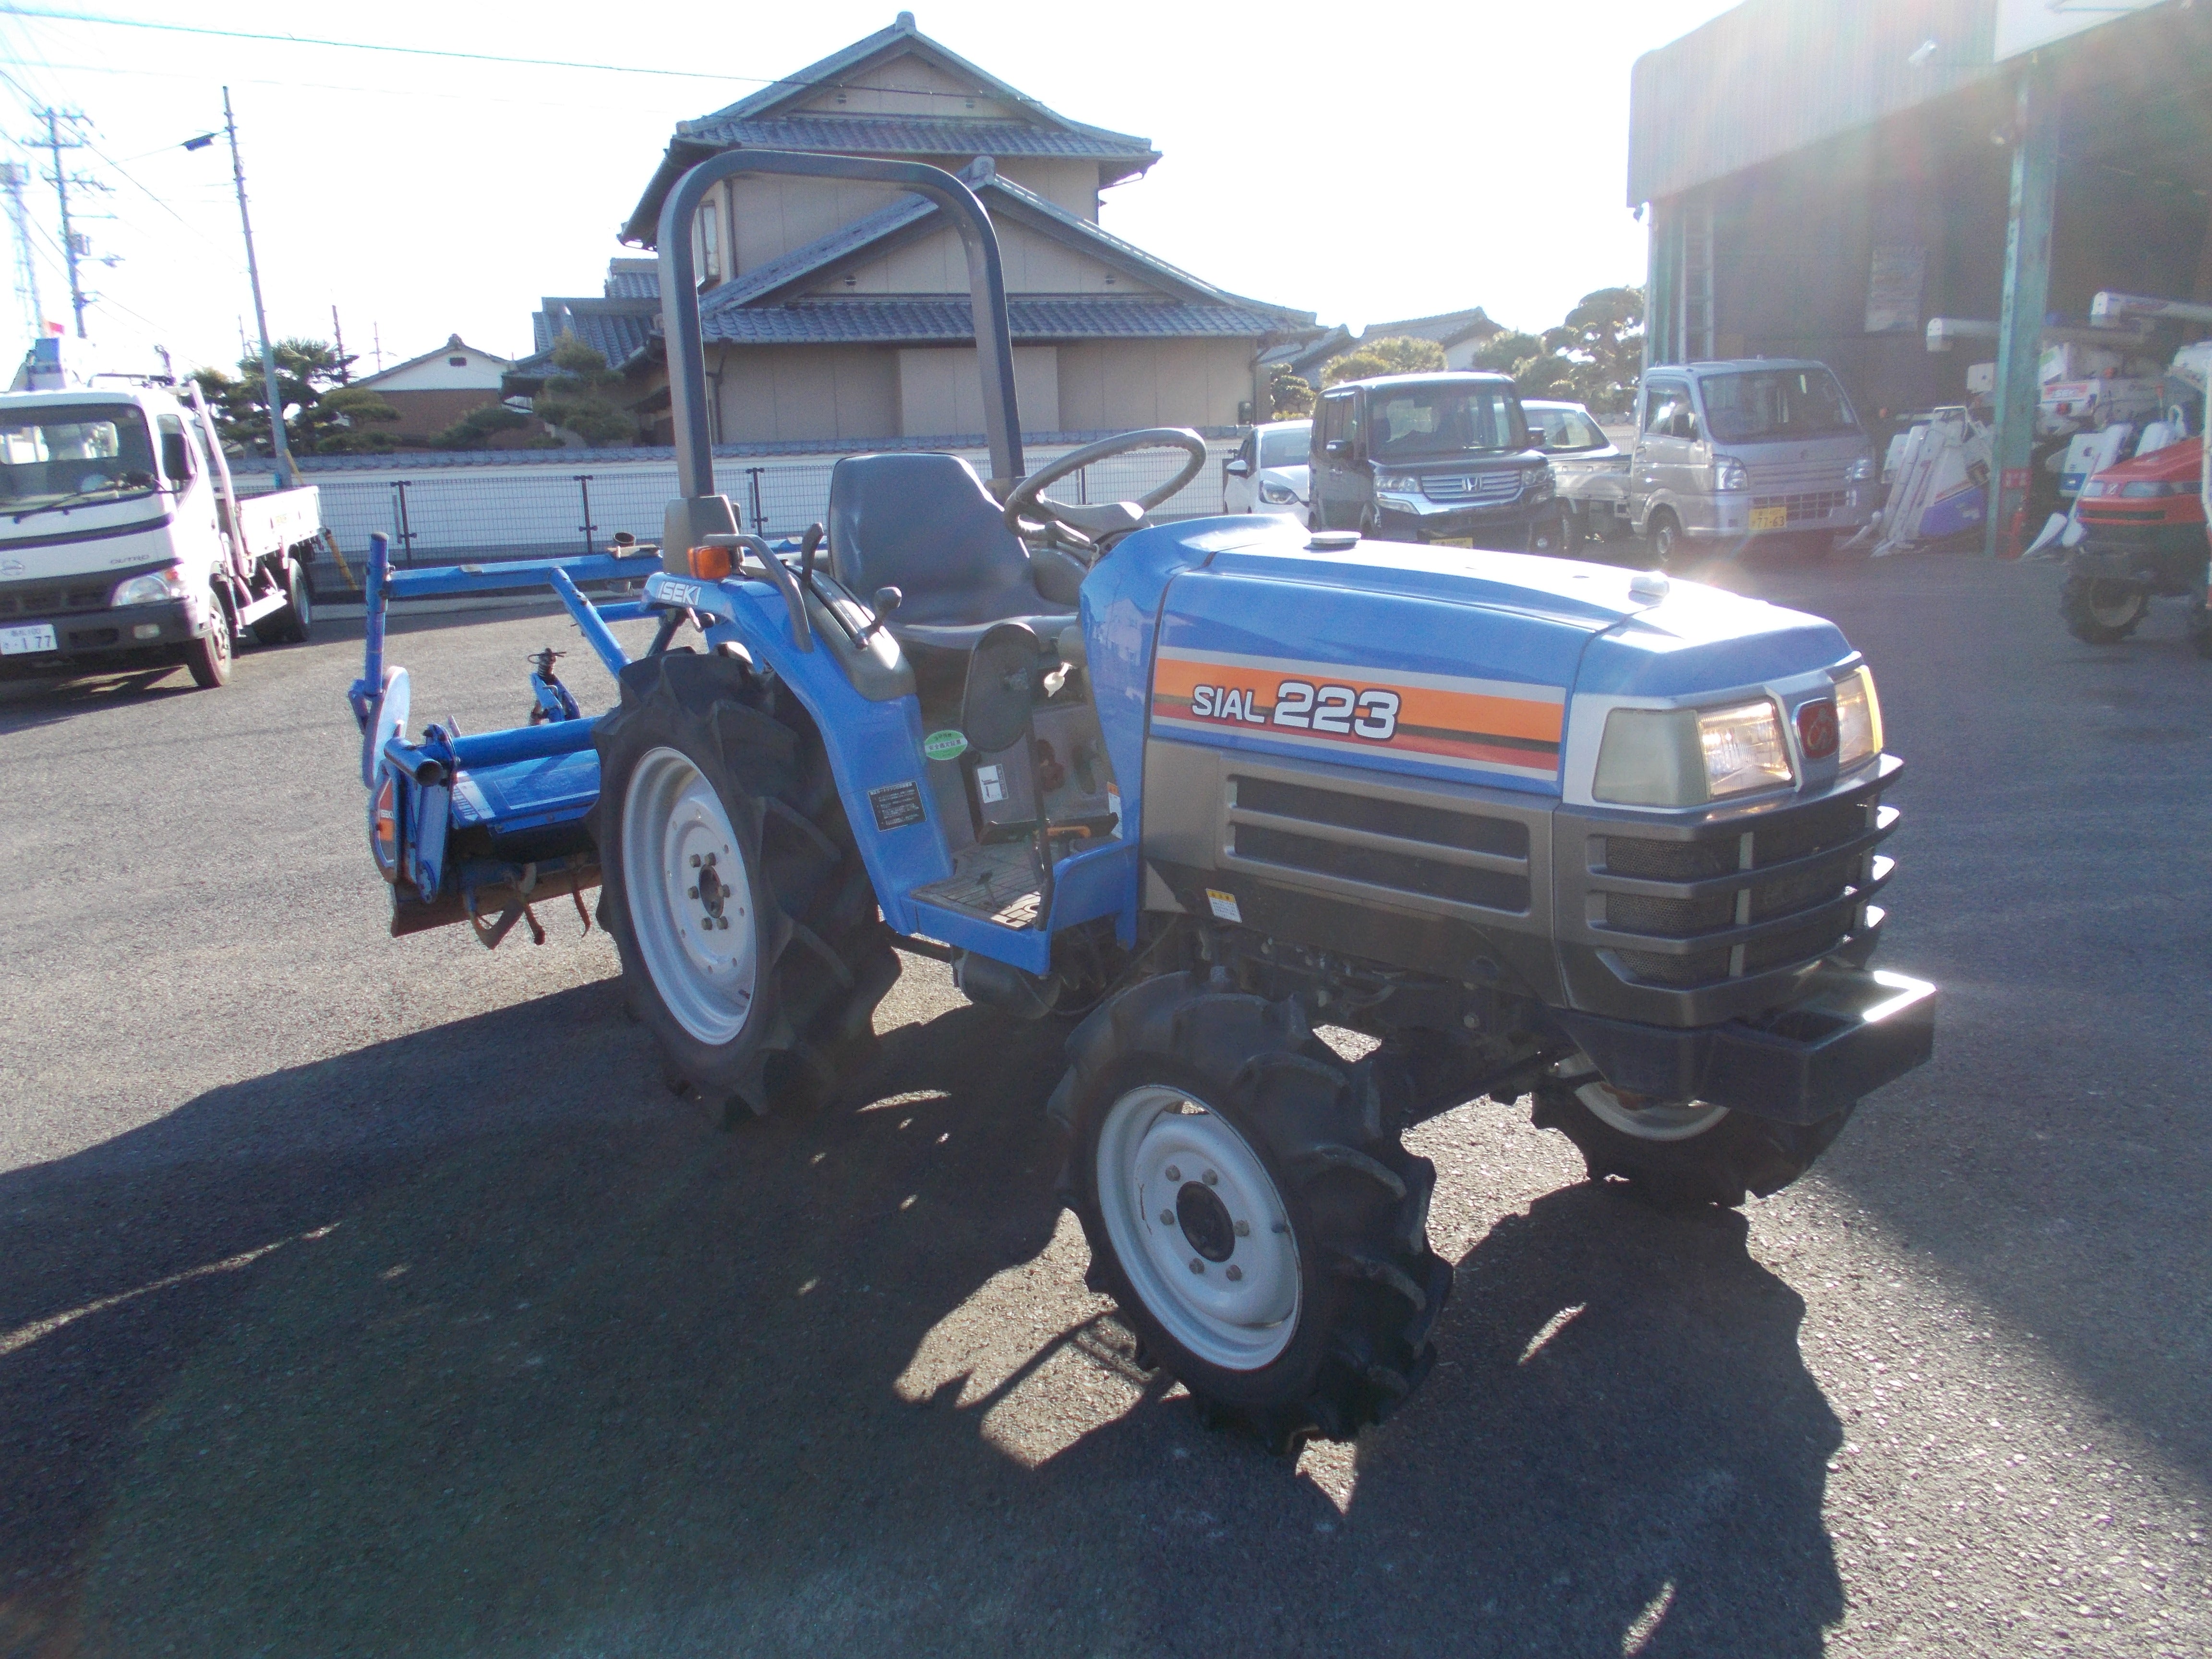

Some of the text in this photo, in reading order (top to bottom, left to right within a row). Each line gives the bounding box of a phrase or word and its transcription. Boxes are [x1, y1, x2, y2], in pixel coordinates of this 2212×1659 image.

[658, 581, 701, 605] ISEKI
[1192, 682, 1399, 739] SIAL 223
